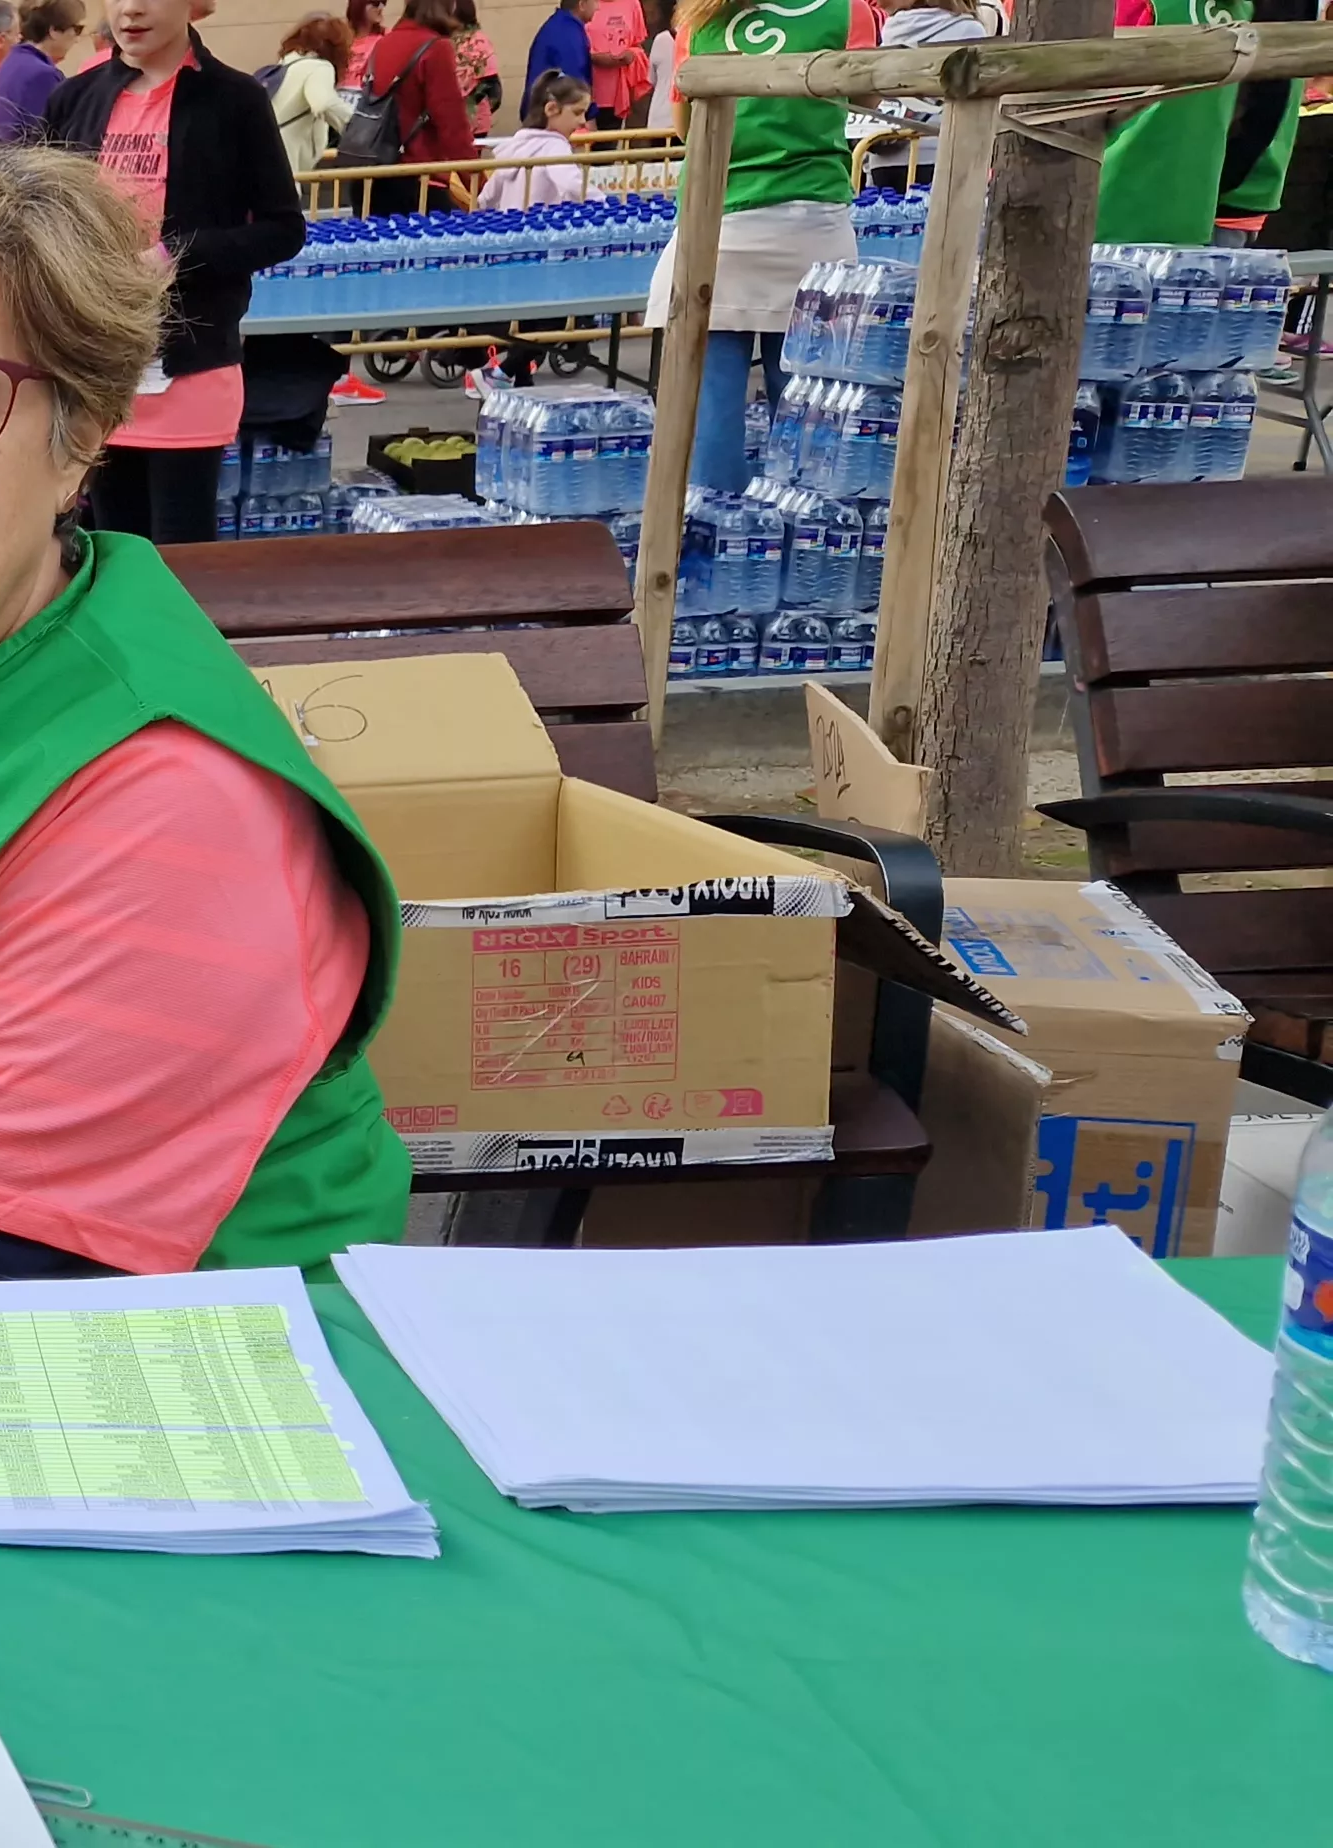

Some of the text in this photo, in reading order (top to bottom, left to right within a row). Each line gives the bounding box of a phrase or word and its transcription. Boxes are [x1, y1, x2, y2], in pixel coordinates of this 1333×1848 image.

[500, 929, 572, 947] ROLY
[619, 950, 669, 967] BAHRAIN
[498, 954, 602, 982] 16 (29)
[632, 976, 662, 990] KIDS
